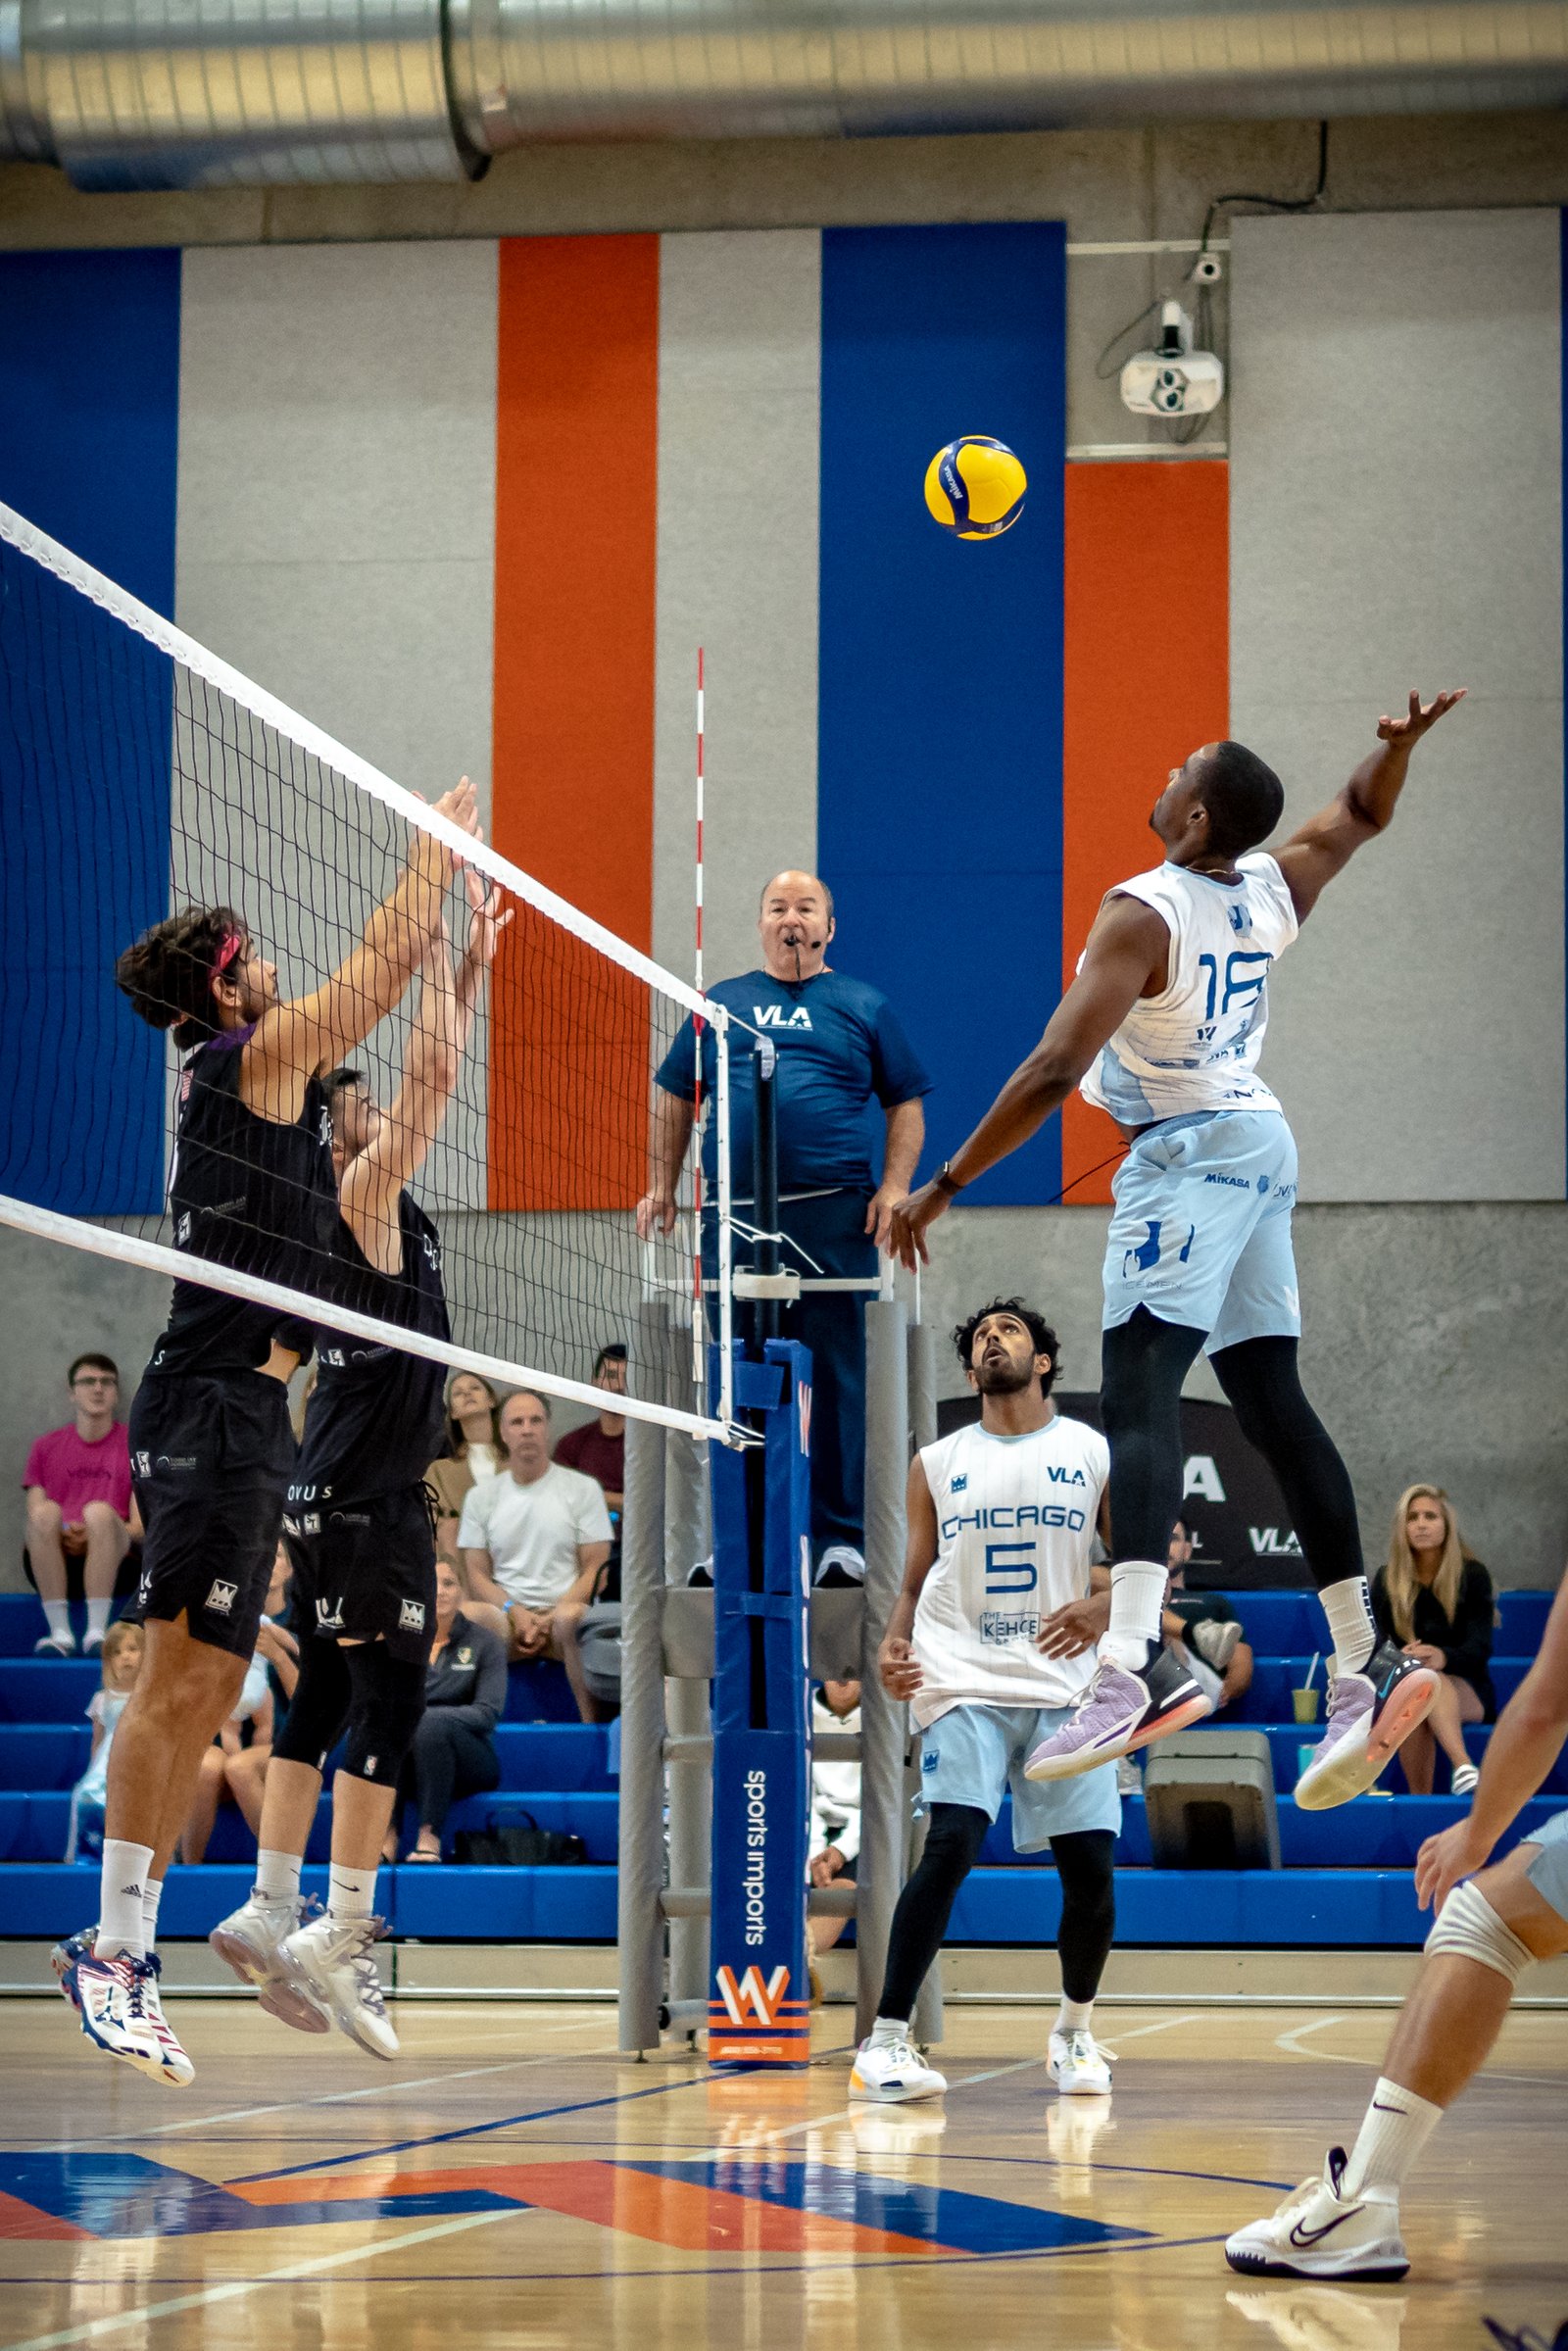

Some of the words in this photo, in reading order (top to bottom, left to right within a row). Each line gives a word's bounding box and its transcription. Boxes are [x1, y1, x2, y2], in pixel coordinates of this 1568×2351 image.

[753, 1004, 812, 1028] VLA
[1047, 1466, 1086, 1488] VLA
[942, 1505, 1086, 1540] CHICAGO
[1249, 1527, 1303, 1553] VLA
[985, 1542, 1038, 1594] 5
[743, 1770, 768, 1847] sports
[742, 1851, 767, 1945] imports
